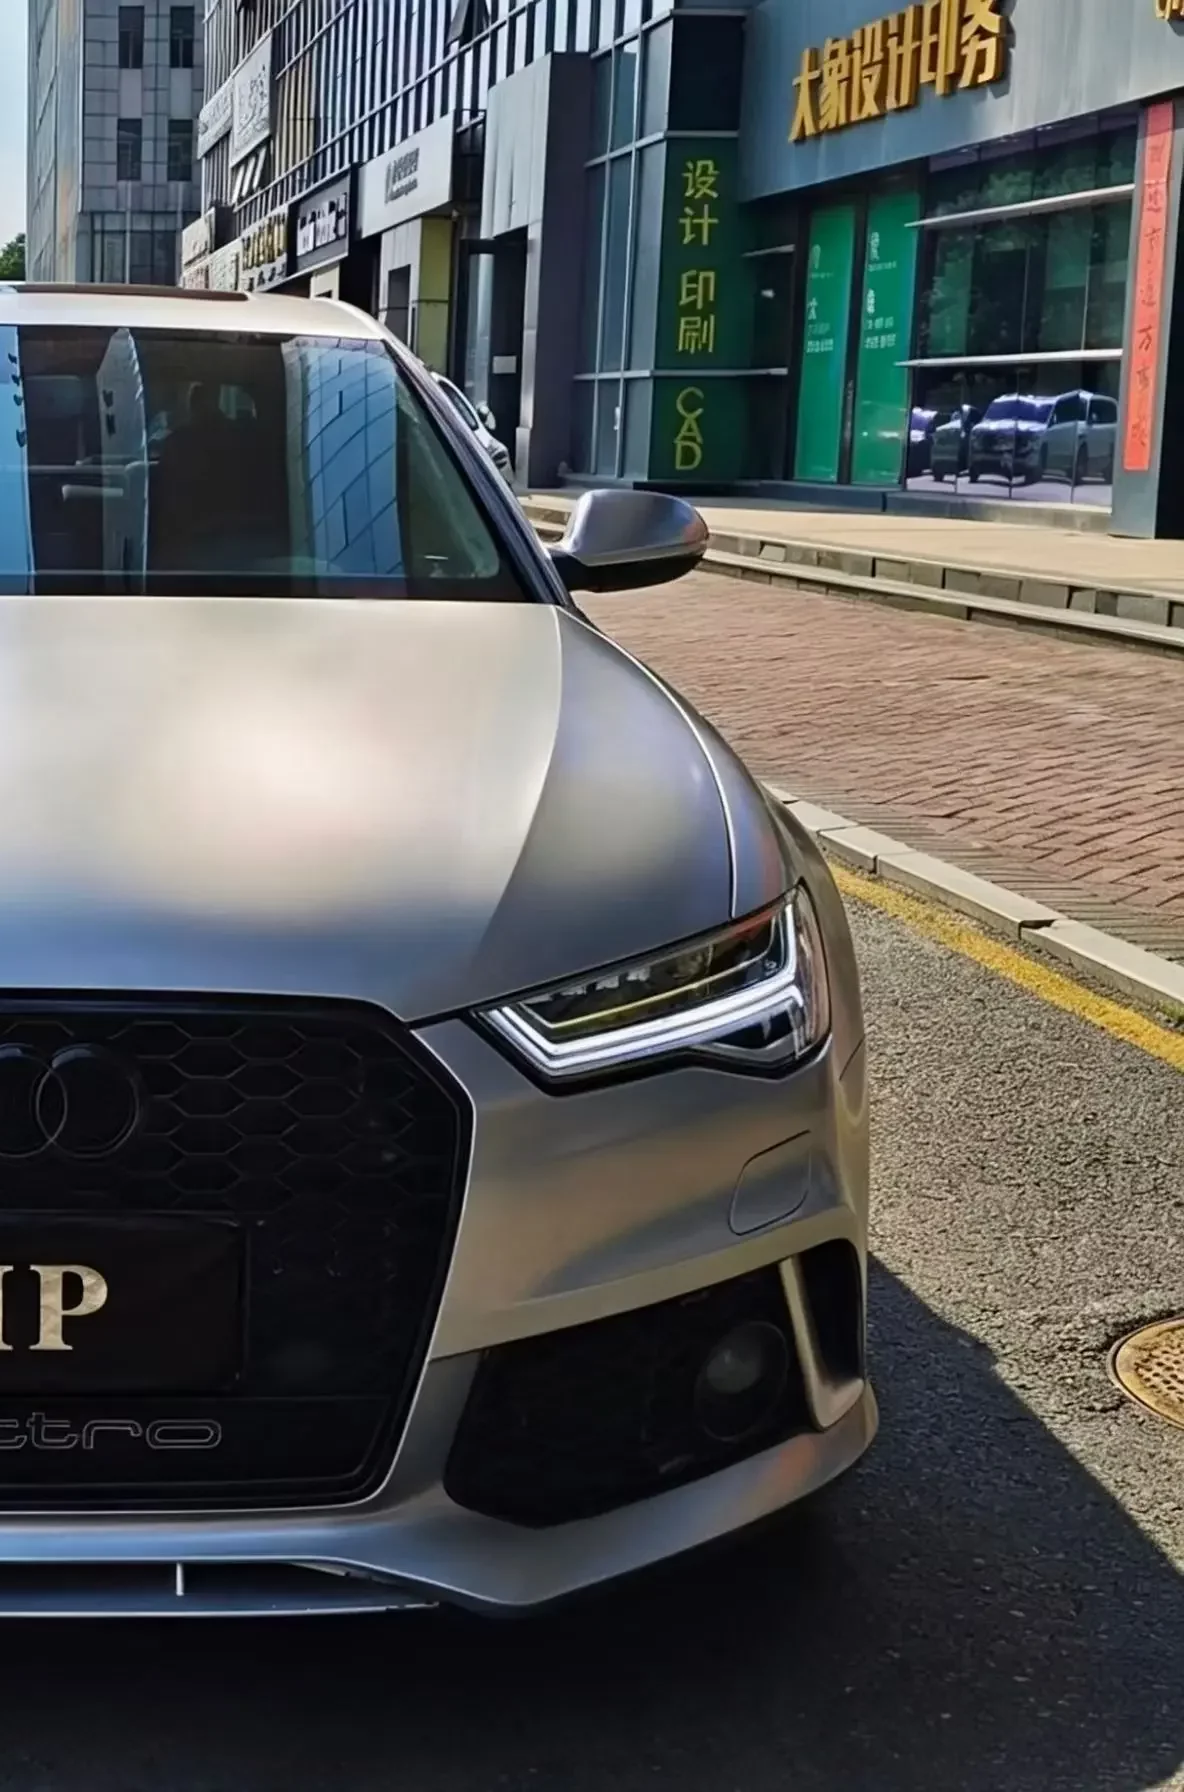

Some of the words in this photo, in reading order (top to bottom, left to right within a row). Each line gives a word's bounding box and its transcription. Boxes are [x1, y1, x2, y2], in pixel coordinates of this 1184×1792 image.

[787, 0, 1003, 143] 大象设计印务
[673, 386, 705, 471] CAD
